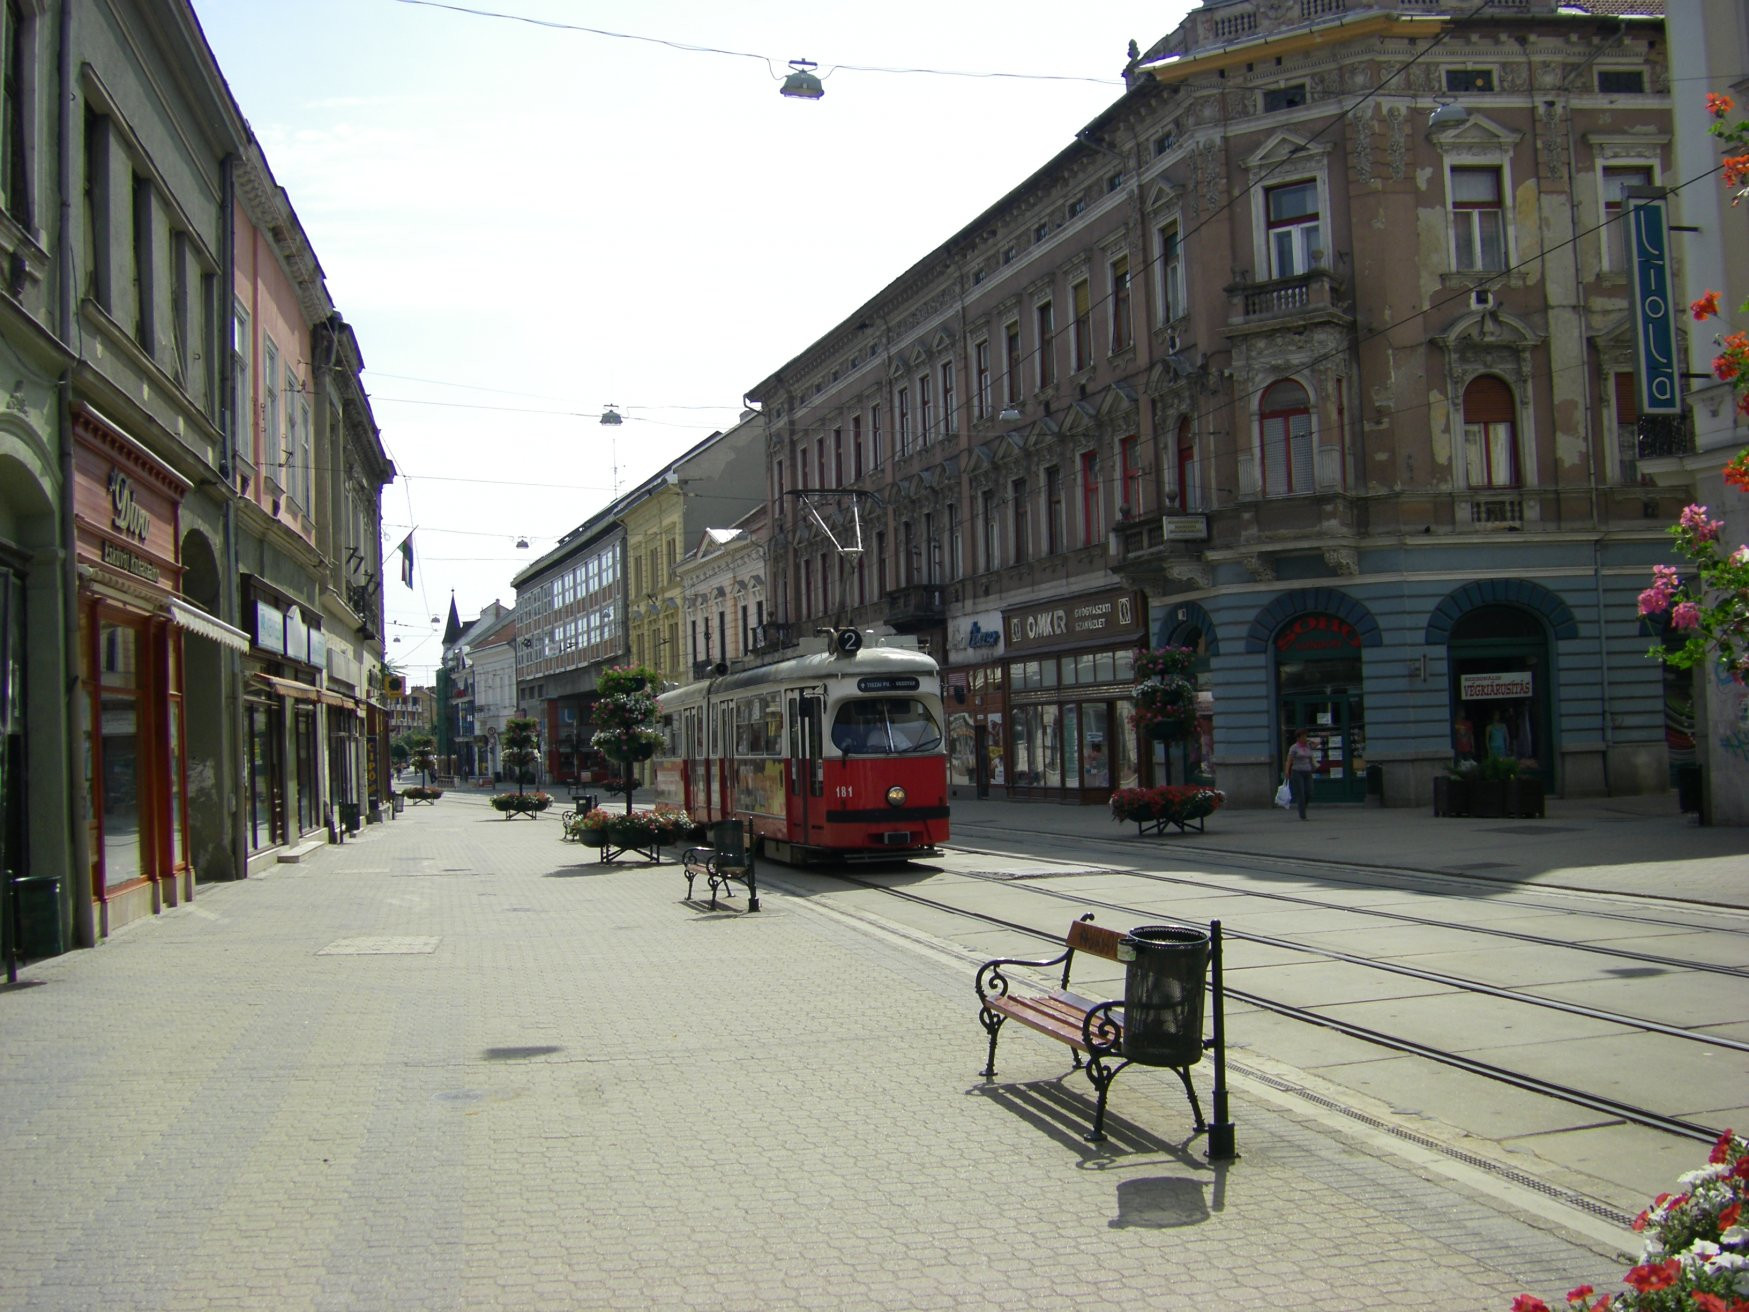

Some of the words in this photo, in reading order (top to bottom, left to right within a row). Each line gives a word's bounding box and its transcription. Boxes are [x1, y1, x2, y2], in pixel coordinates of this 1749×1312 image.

[844, 632, 857, 650] 2
[1276, 616, 1361, 651] SOHO
[1463, 680, 1530, 698] VÉGKIÁRUSÍTÁS
[836, 785, 853, 798] 181
